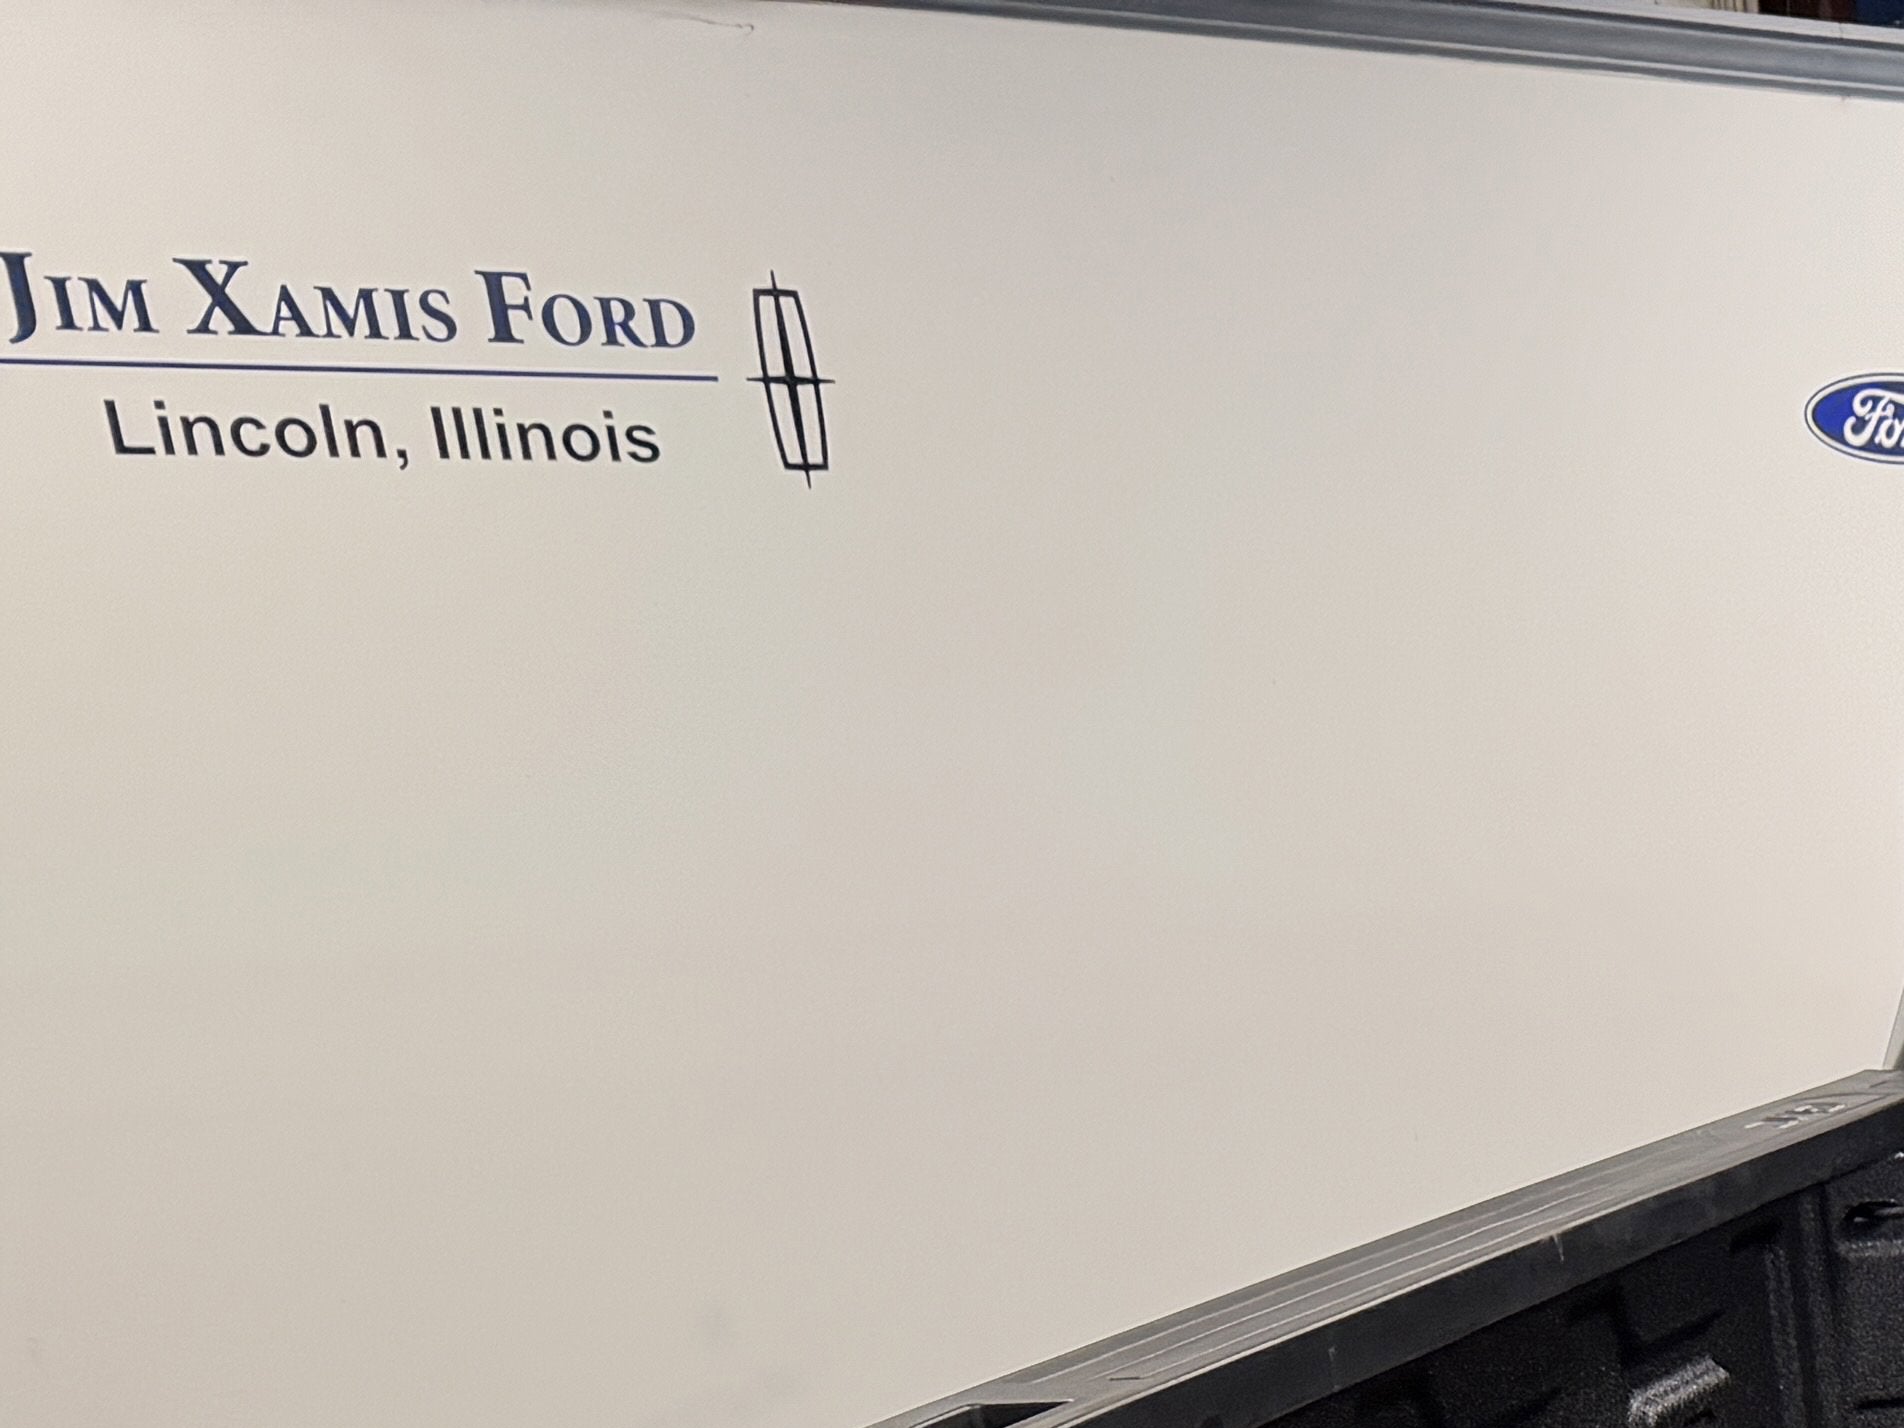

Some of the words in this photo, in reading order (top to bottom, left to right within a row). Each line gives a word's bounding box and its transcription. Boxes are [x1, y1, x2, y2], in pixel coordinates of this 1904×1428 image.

[0, 251, 160, 345] JIM
[172, 257, 458, 343] XAMIS
[473, 269, 696, 349] FORD
[103, 399, 409, 471] Lincoln,
[430, 406, 661, 464] Illinois
